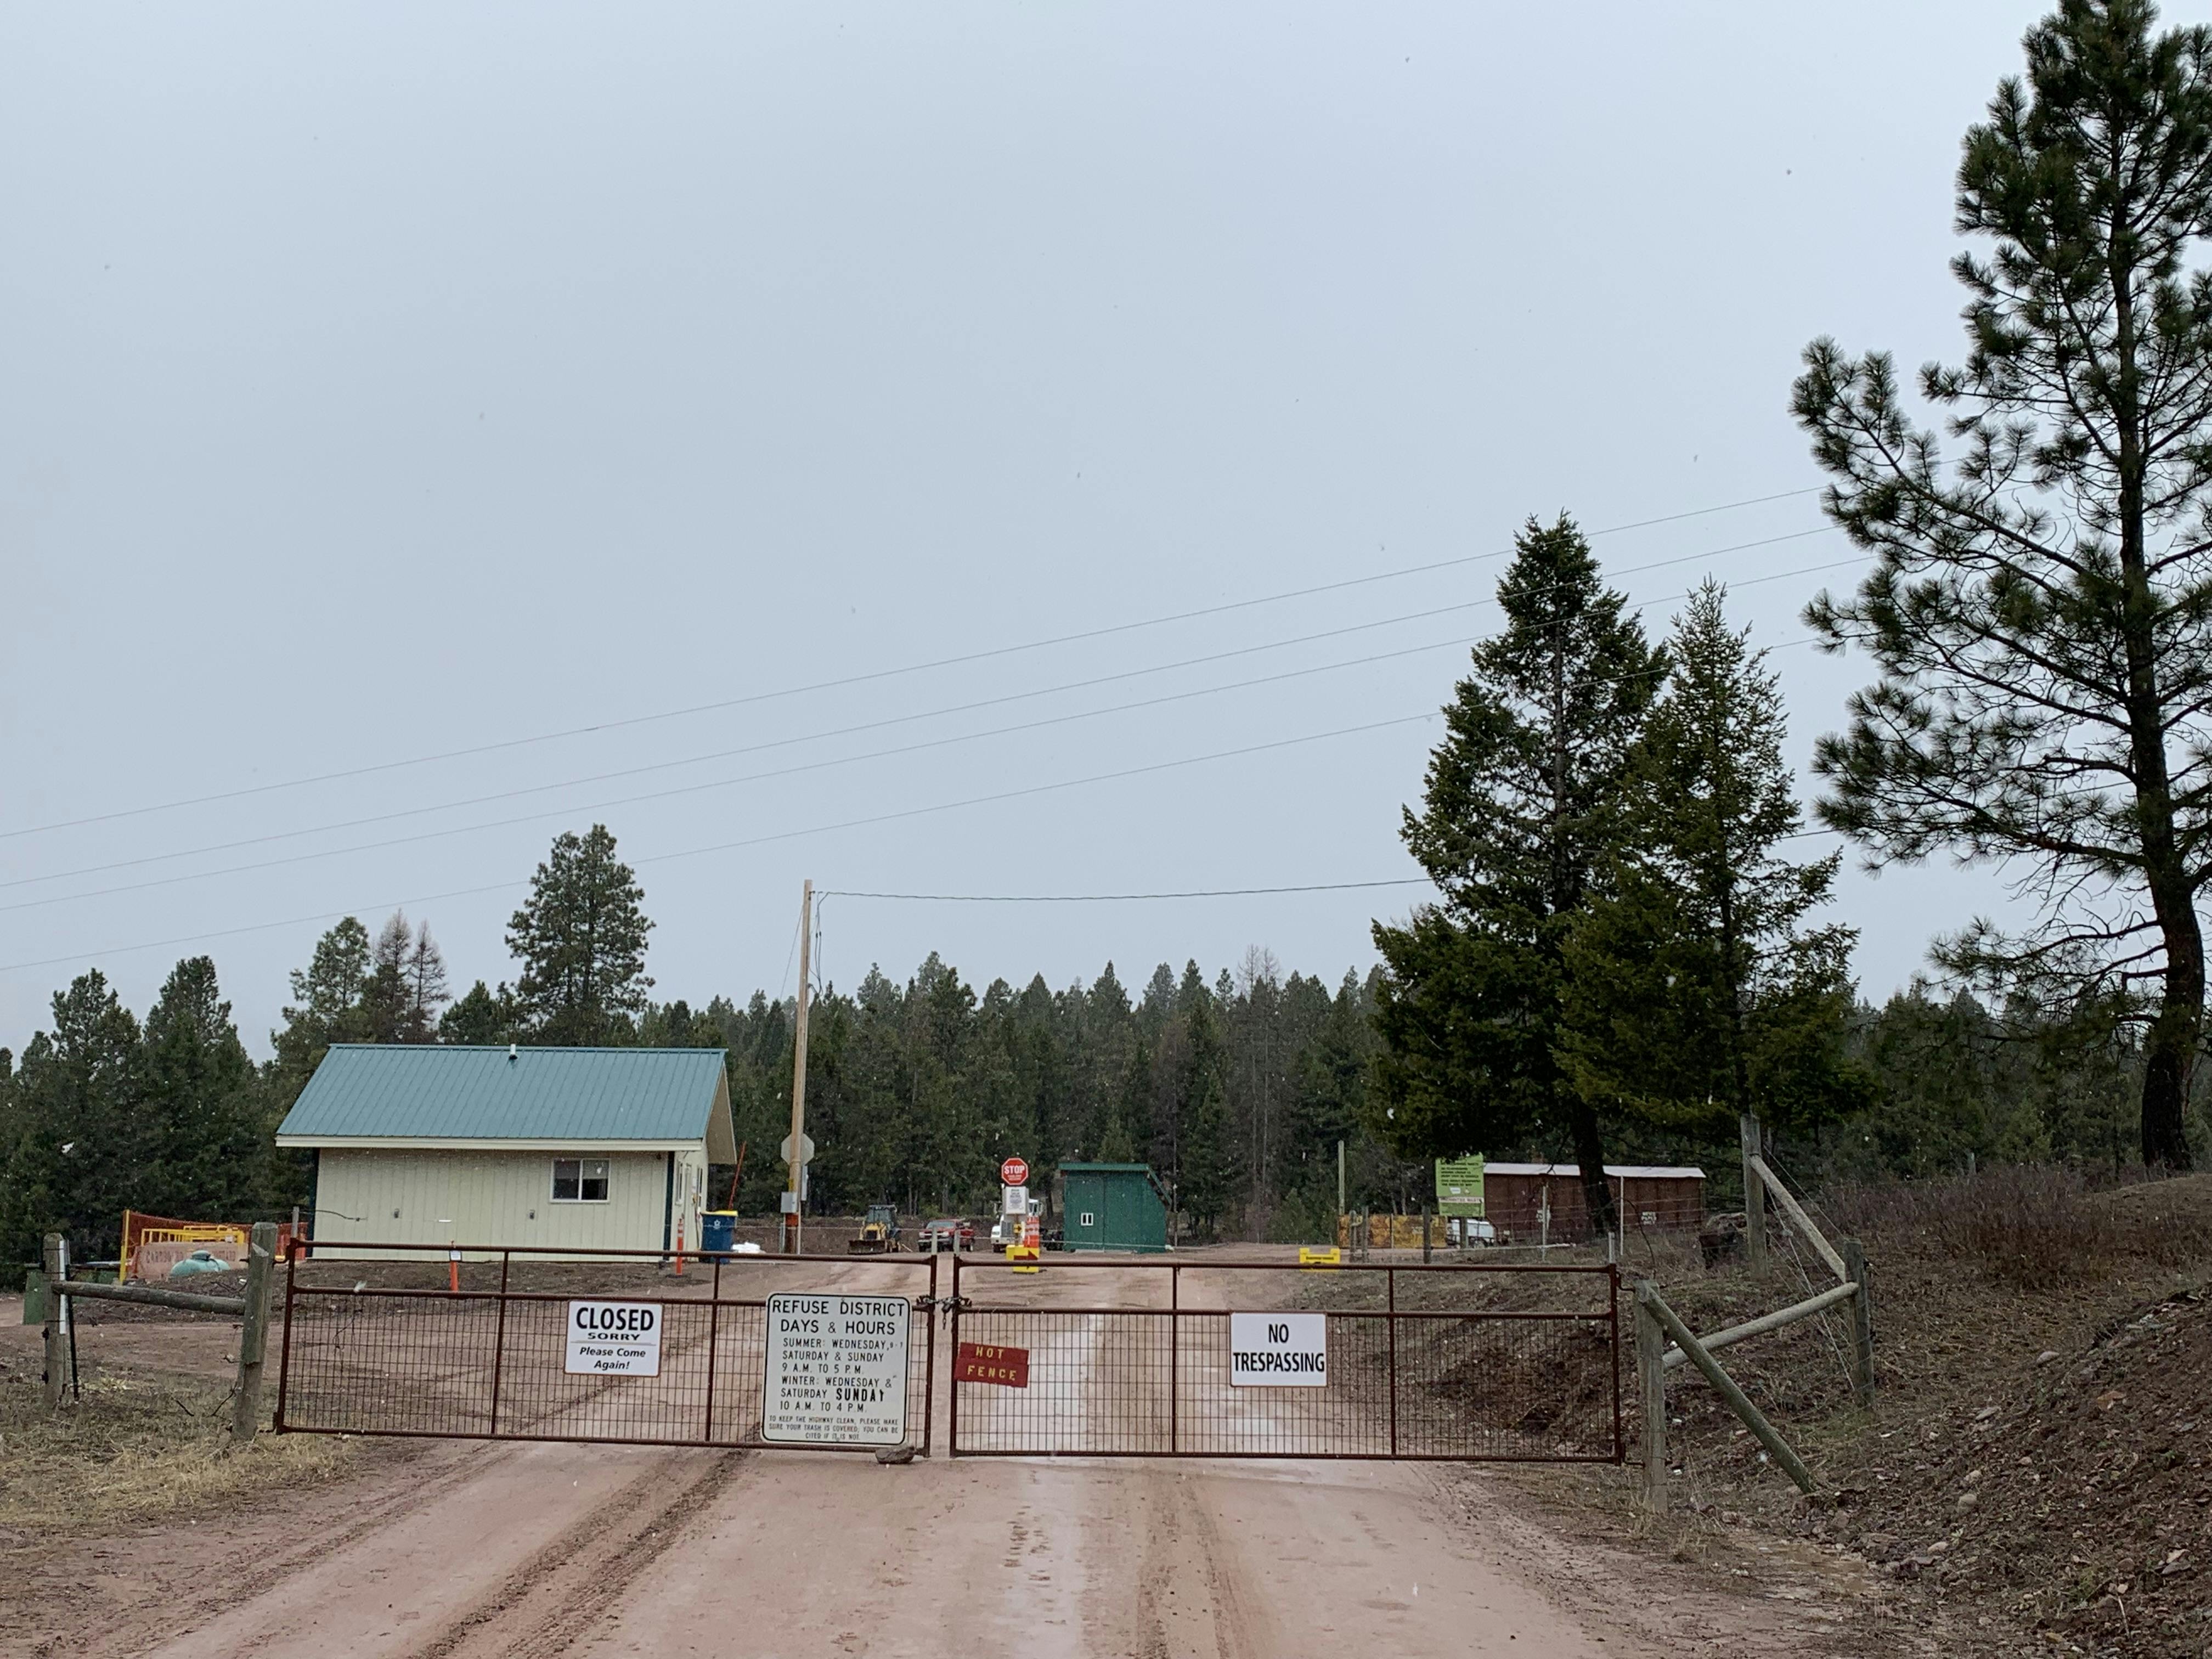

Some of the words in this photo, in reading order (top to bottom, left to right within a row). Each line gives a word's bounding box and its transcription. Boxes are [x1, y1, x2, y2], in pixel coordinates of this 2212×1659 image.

[1004, 1165, 1025, 1175] STOP
[772, 1300, 830, 1314] REFUSE
[840, 1301, 905, 1317] DISTRICT
[576, 1307, 654, 1331] CLOSED
[781, 1319, 819, 1333] DAYS
[828, 1322, 837, 1334] &
[845, 1321, 895, 1335] HOURS
[588, 1332, 640, 1341] SORRY
[1268, 1324, 1289, 1343] NO
[783, 1338, 825, 1348] SUMMER:
[832, 1339, 889, 1351] WEDNESDAY,
[579, 1347, 613, 1356] Please
[617, 1348, 646, 1357] Come
[782, 1351, 828, 1361] SATURDAY
[834, 1352, 842, 1361] &
[848, 1352, 884, 1362] SUNDAY
[594, 1360, 630, 1371] Again!
[782, 1362, 788, 1372] 9
[793, 1363, 812, 1373] A.M.
[819, 1363, 828, 1373] TO
[834, 1364, 839, 1373] 5
[1233, 1352, 1324, 1372] TRESPASSING
[967, 1365, 1017, 1381] FENCE
[782, 1375, 820, 1385] WINTER:
[826, 1377, 879, 1387] WEDNESDAY
[885, 1378, 892, 1387] &
[781, 1387, 827, 1398] SATURDAY
[836, 1388, 884, 1402] SUNDAY
[780, 1400, 789, 1410] 10
[795, 1401, 815, 1411] A.M.
[821, 1402, 831, 1411] TO
[837, 1403, 842, 1412] 4
